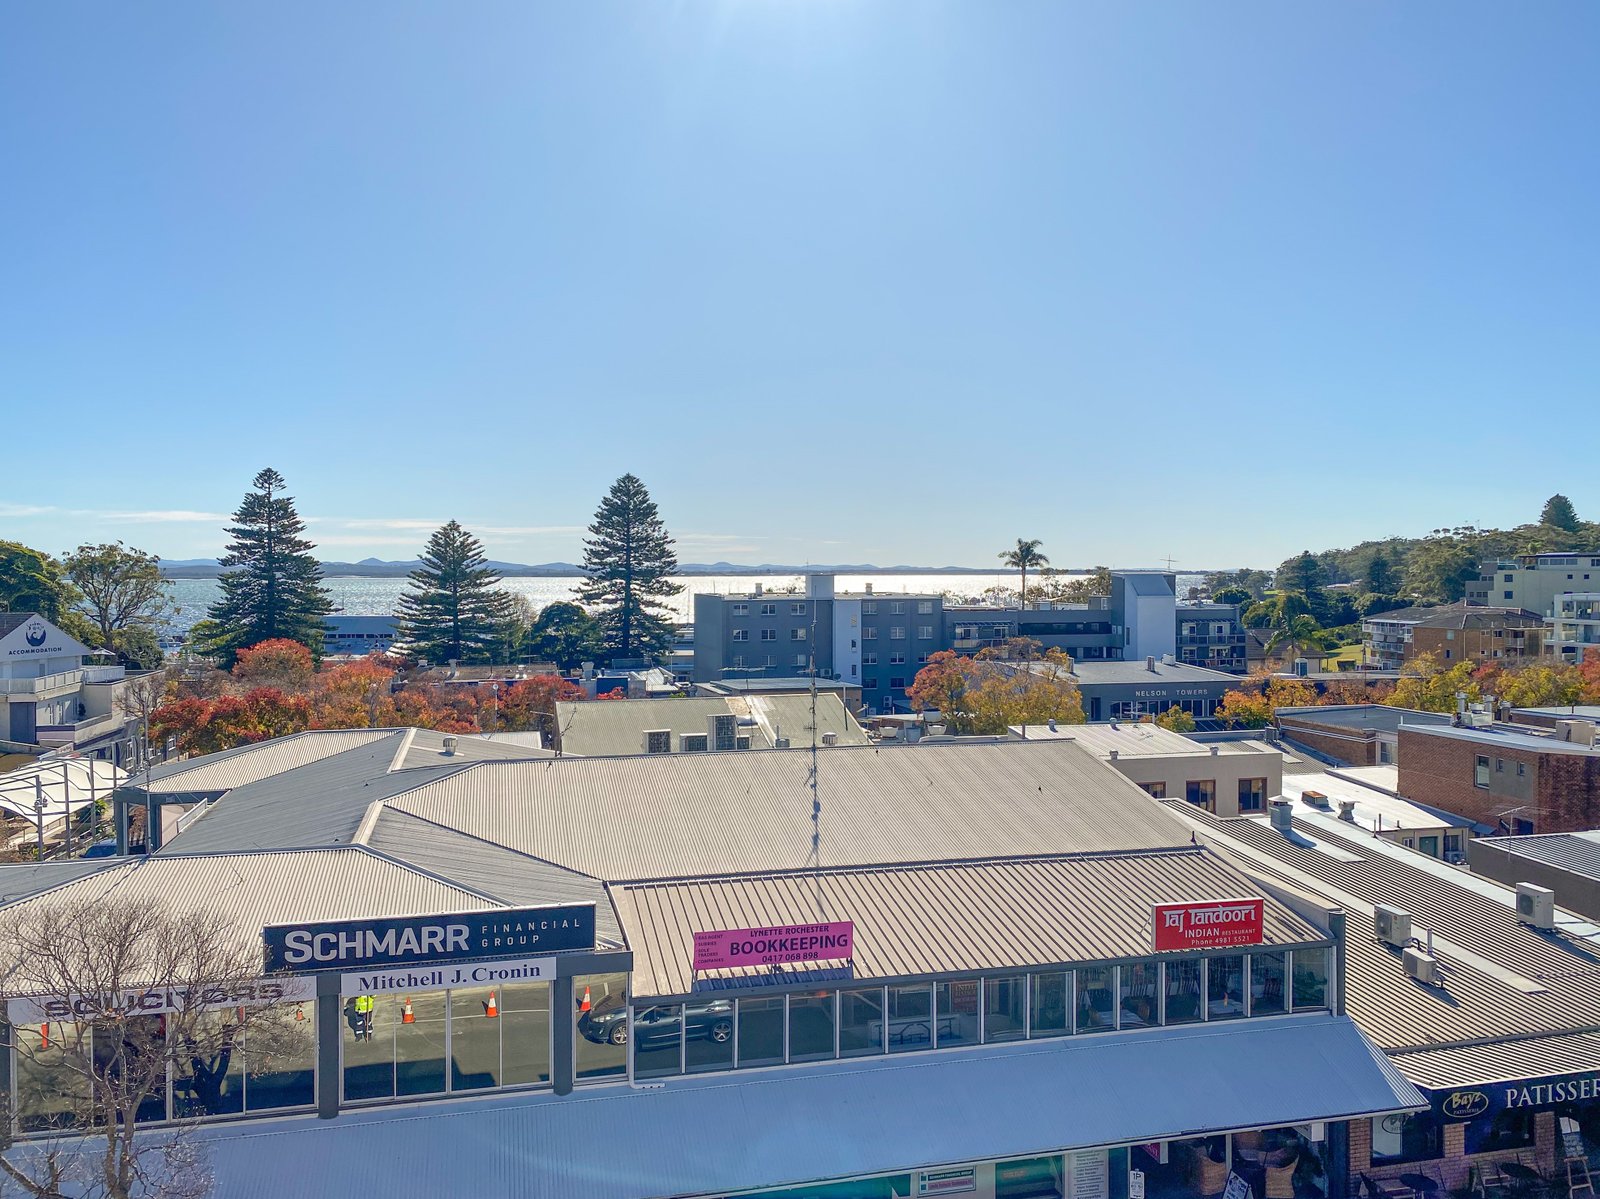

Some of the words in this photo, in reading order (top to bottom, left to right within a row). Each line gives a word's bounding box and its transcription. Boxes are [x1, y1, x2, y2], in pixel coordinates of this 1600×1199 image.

[8, 647, 62, 656] ACCOMMODATION
[481, 918, 580, 934] FINANCIAL
[1162, 909, 1187, 933] Taj
[1187, 904, 1257, 926] Tandoori
[750, 927, 783, 938] LYNETTE
[785, 925, 830, 936] ROCHESTER
[1185, 928, 1220, 938] INDIAN
[1221, 928, 1256, 937] RESTAURANT
[284, 924, 470, 964] SCHMARR
[481, 934, 540, 948] GROUP
[729, 934, 849, 956] BOOKKEEPING
[1191, 937, 1213, 946] Phone
[762, 953, 783, 963] 0417
[785, 952, 801, 962] 068
[802, 951, 819, 960] 898
[358, 970, 443, 992] Mitchell
[451, 969, 467, 984] J.
[471, 963, 541, 982] Cronin
[1452, 1092, 1482, 1110] Bayz
